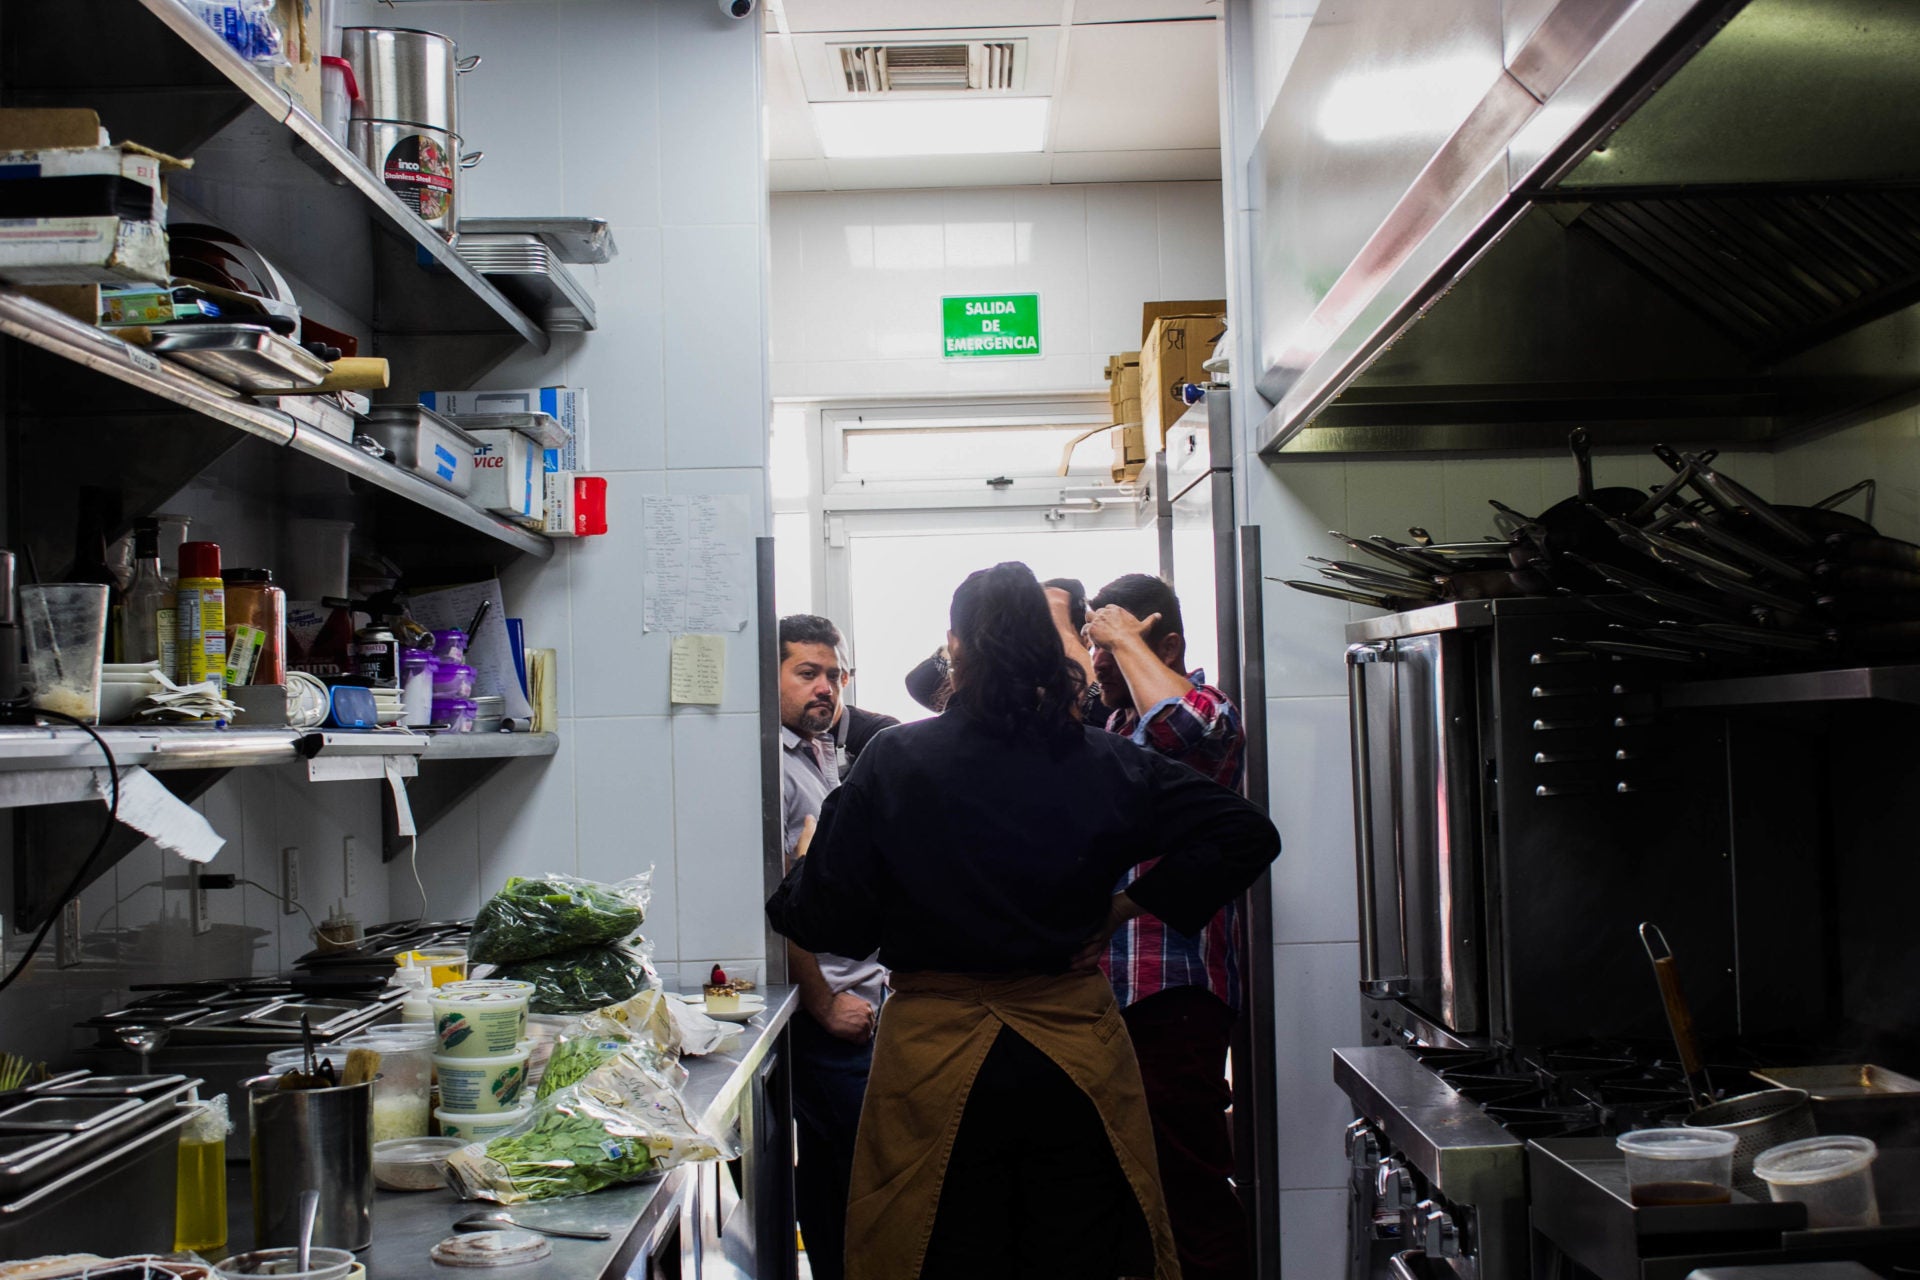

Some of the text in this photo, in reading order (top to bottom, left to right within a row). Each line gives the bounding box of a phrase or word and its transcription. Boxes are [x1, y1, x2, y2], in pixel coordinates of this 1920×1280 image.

[386, 158, 420, 171] inco
[385, 172, 431, 183] Stainless Steel
[965, 301, 1016, 316] SALIDA
[981, 319, 1000, 332] DE
[946, 336, 1038, 352] EMERGENCIA
